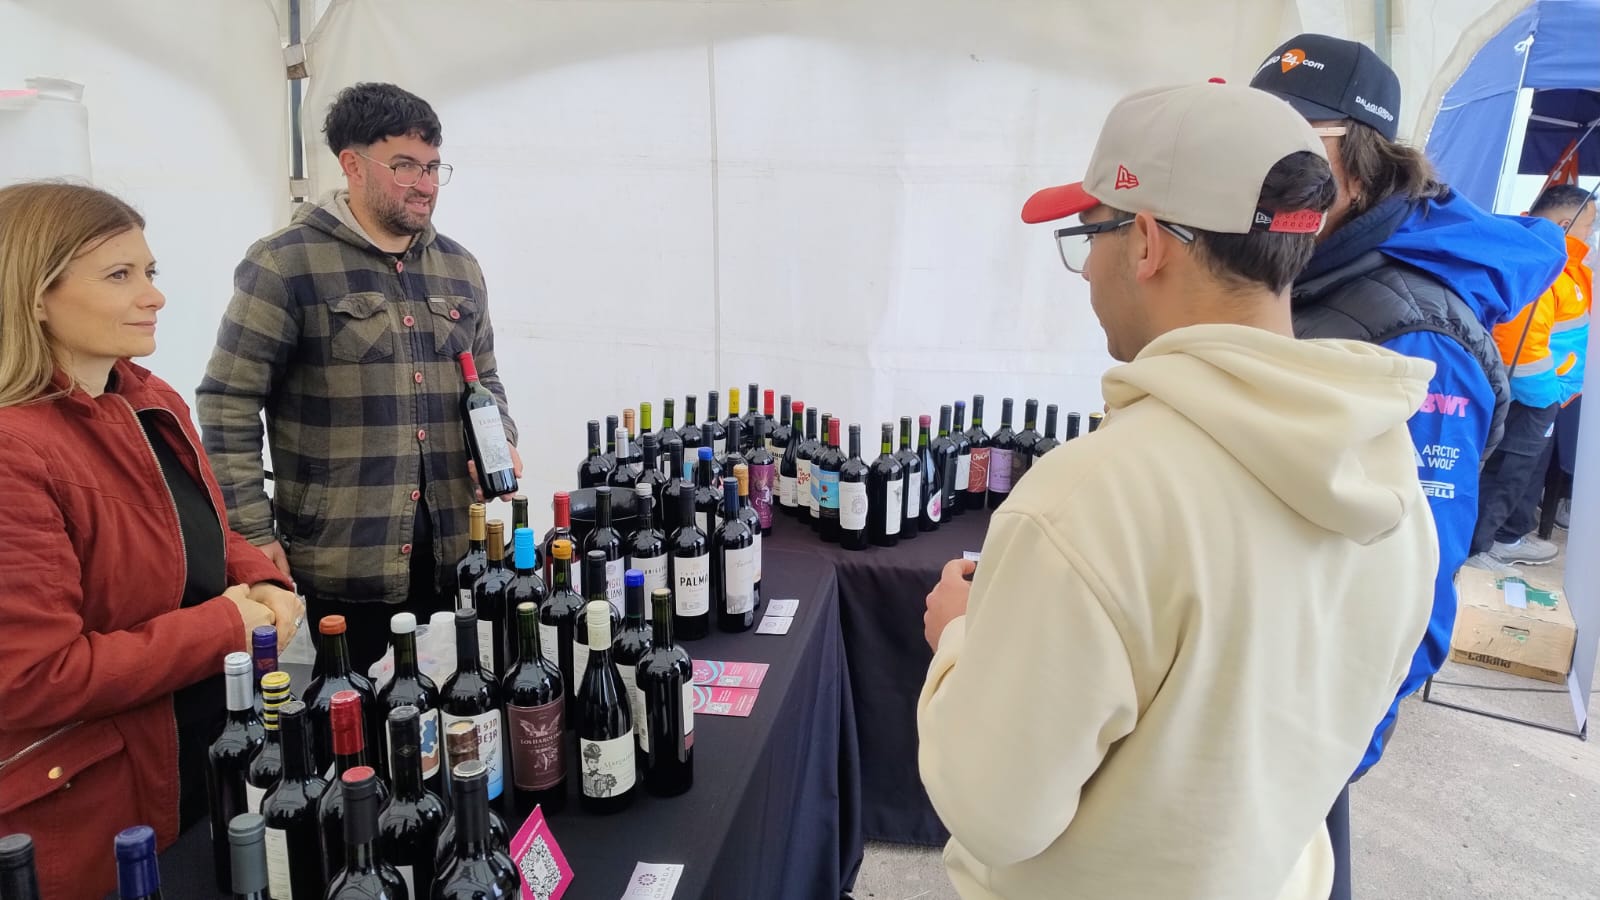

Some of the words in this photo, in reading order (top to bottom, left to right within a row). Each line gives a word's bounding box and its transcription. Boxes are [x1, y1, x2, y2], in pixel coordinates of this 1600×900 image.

[1420, 393, 1470, 417] BWT
[1422, 444, 1460, 459] ARCTIC
[1427, 456, 1455, 470] WOLF
